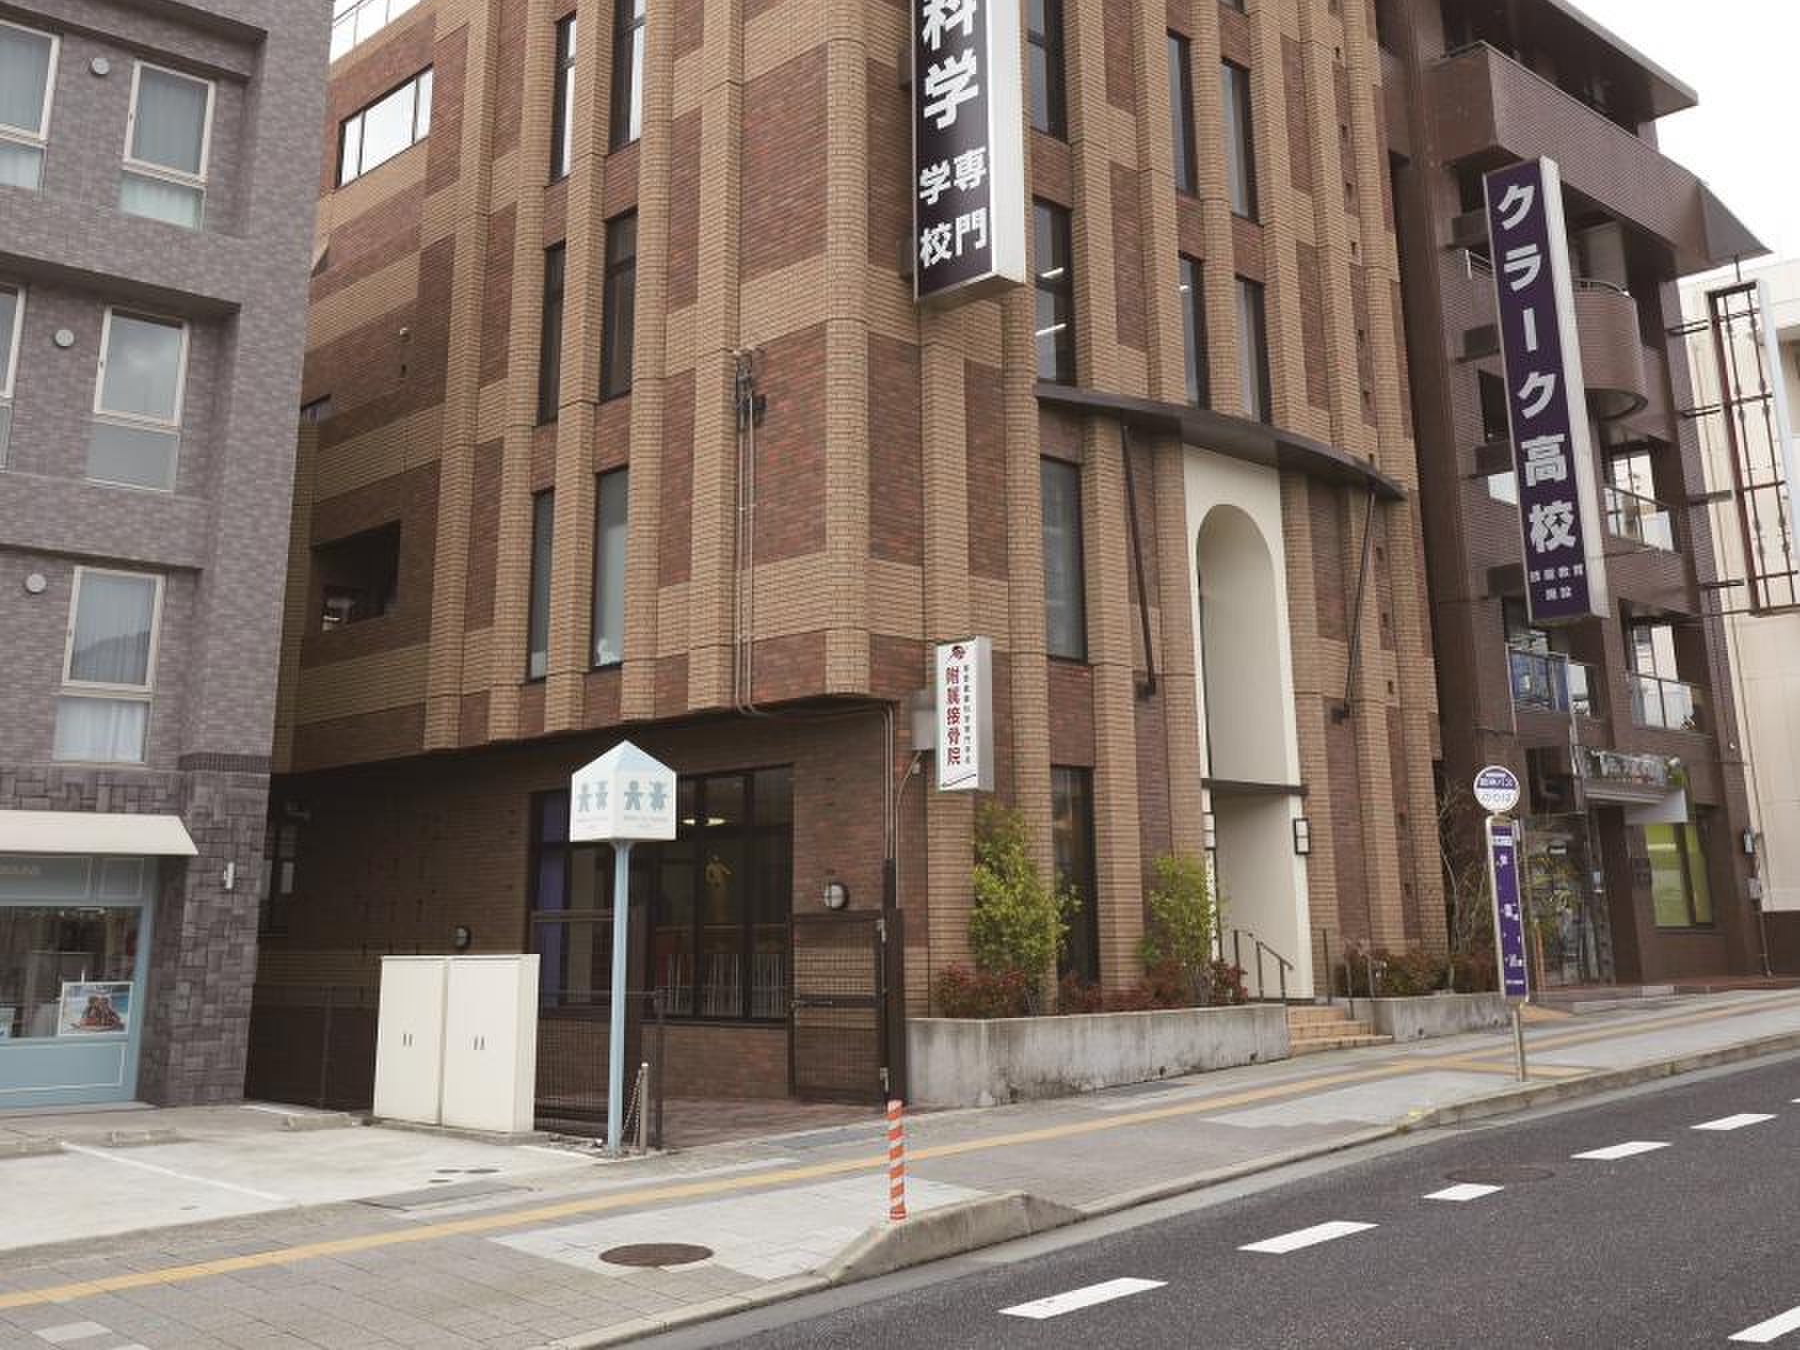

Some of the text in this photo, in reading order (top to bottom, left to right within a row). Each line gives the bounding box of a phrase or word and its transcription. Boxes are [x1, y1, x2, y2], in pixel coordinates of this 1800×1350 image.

[918, 160, 954, 269] 学校
[954, 147, 988, 253] 専門
[1497, 183, 1576, 555] クラーク高校
